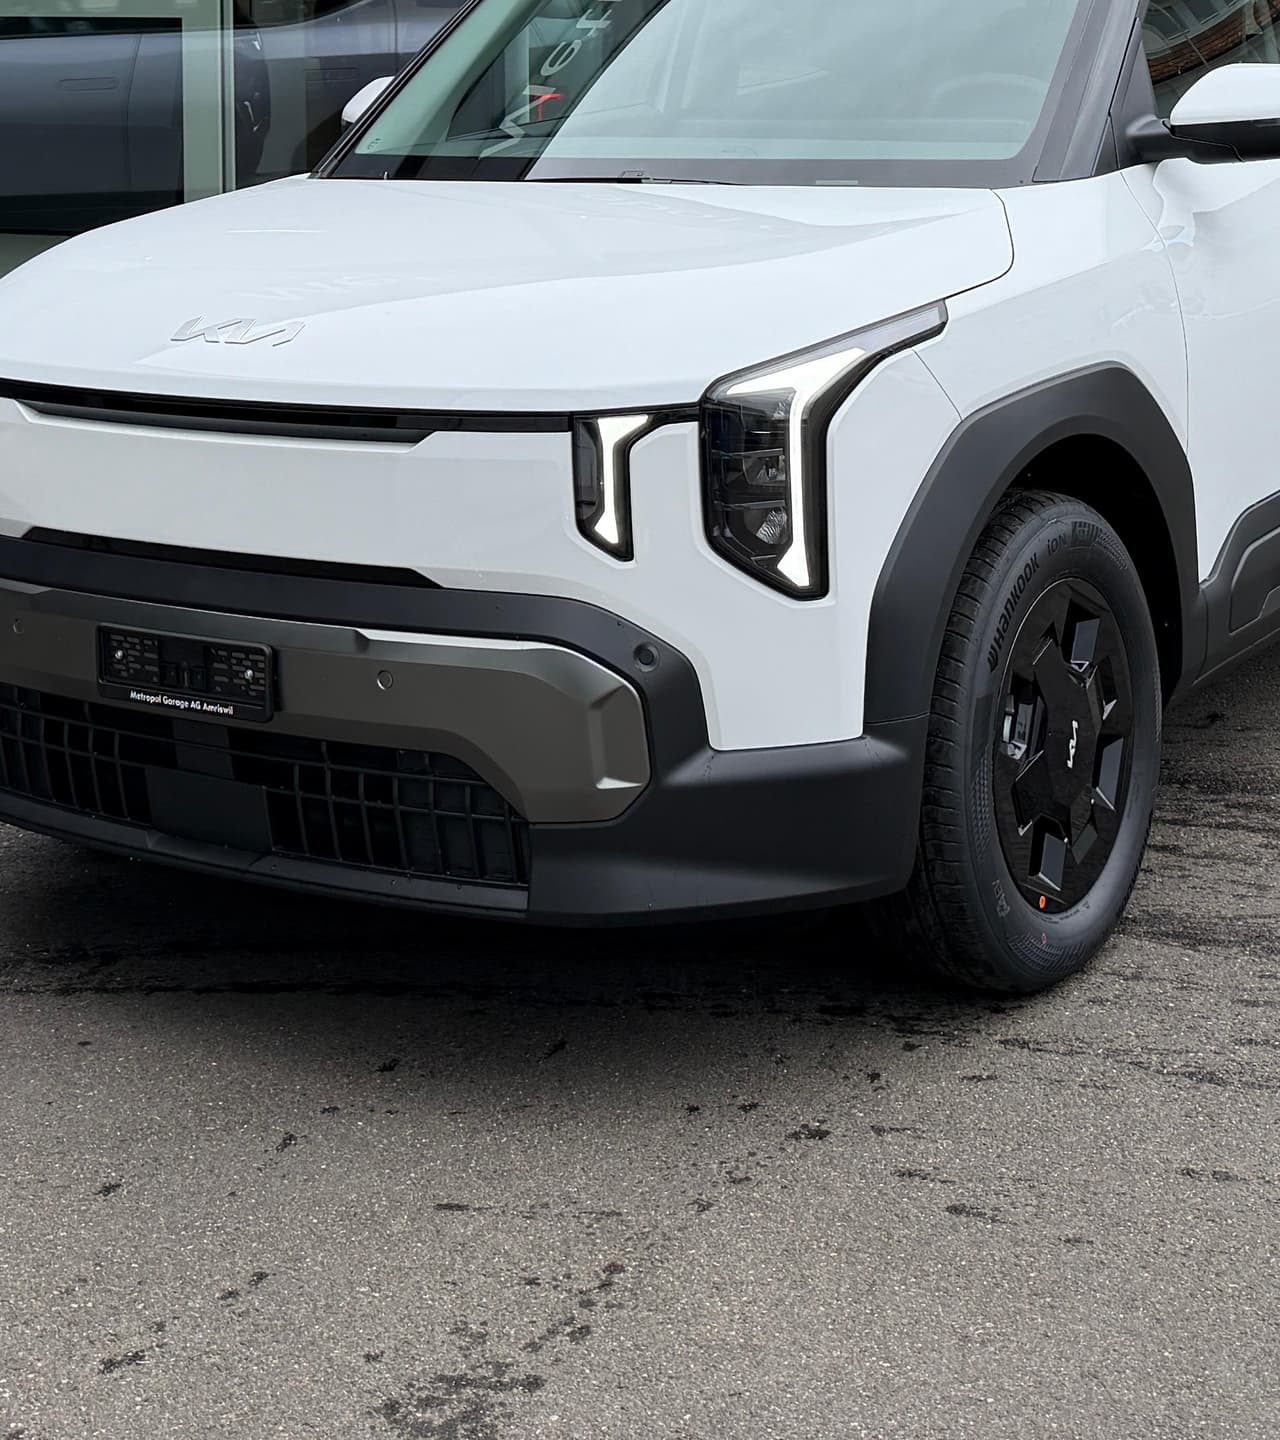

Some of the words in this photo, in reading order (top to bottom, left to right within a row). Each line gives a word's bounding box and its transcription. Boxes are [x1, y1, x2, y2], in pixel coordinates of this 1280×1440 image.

[170, 314, 306, 347] KIA
[130, 690, 161, 703] Metropol
[163, 696, 189, 709] Garage
[191, 701, 201, 710] AG
[203, 702, 234, 715] Amriswil
